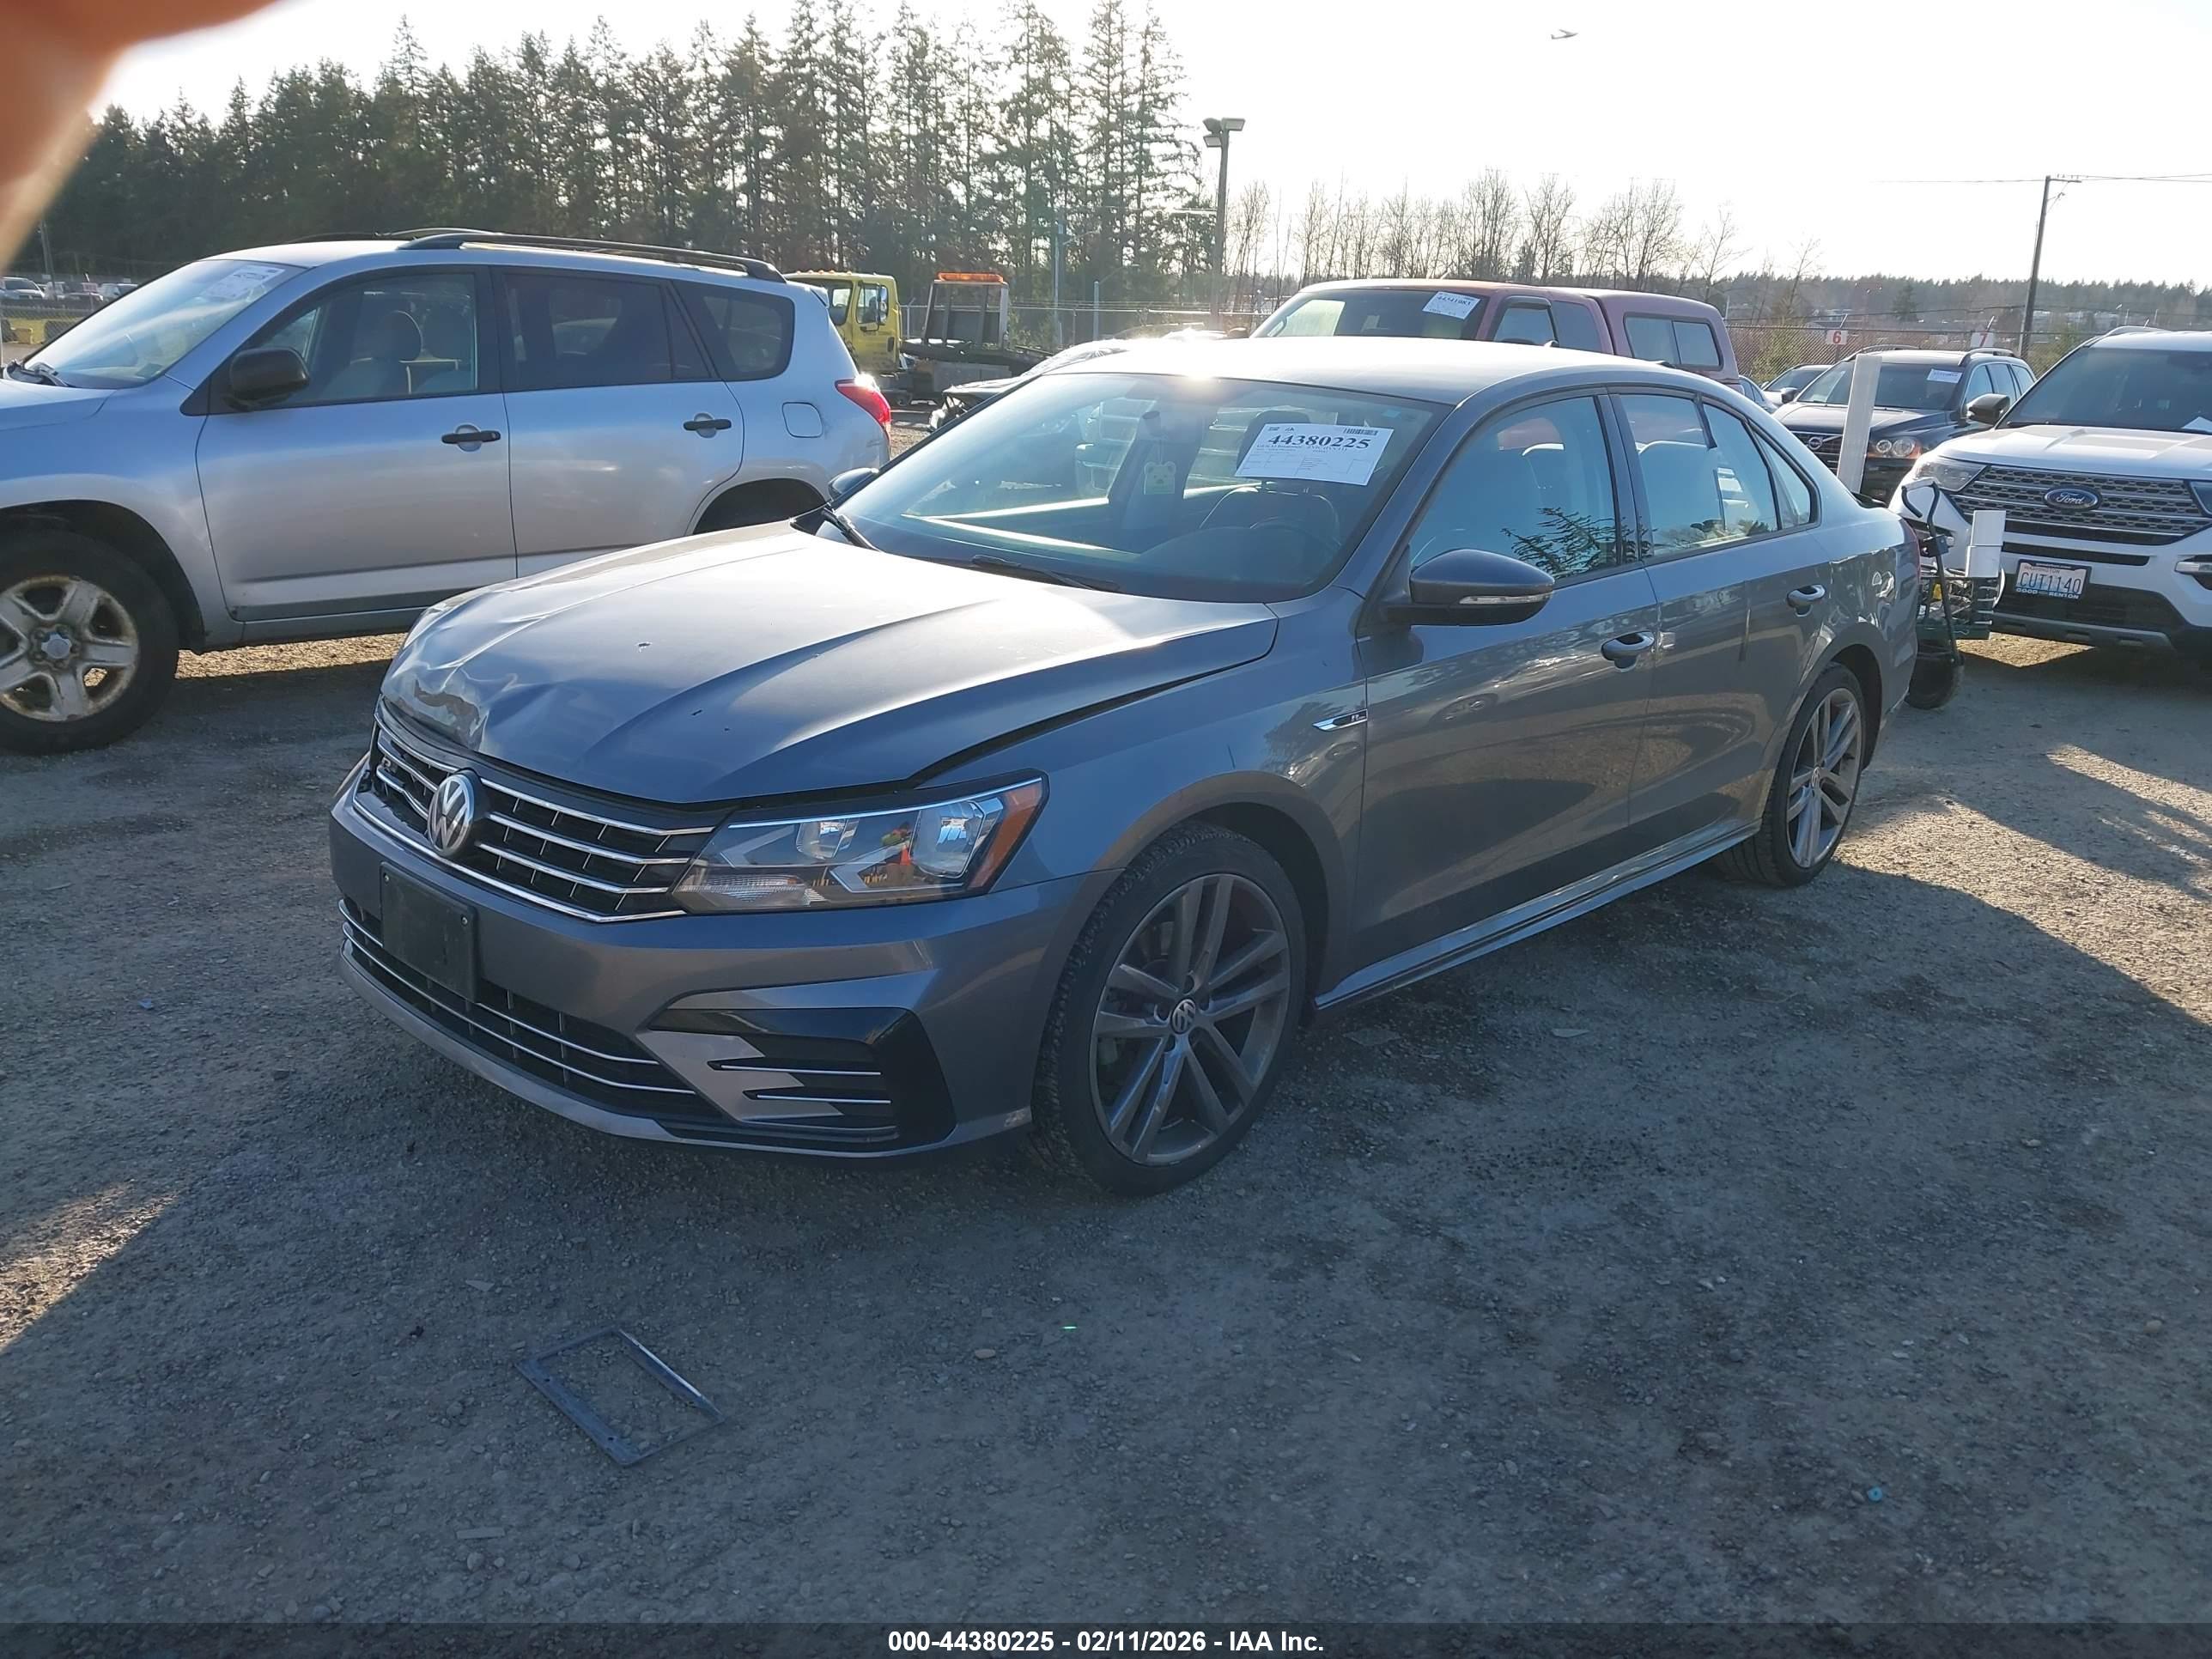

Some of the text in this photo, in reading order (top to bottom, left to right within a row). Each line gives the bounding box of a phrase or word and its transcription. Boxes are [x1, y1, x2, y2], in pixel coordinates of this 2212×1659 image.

[1832, 331, 1842, 344] 6
[1979, 331, 1989, 348] 7
[1268, 434, 1372, 449] 44380225
[2057, 492, 2085, 504] Ford
[2020, 572, 2081, 594] CUT1140
[2048, 592, 2079, 600] RENTON
